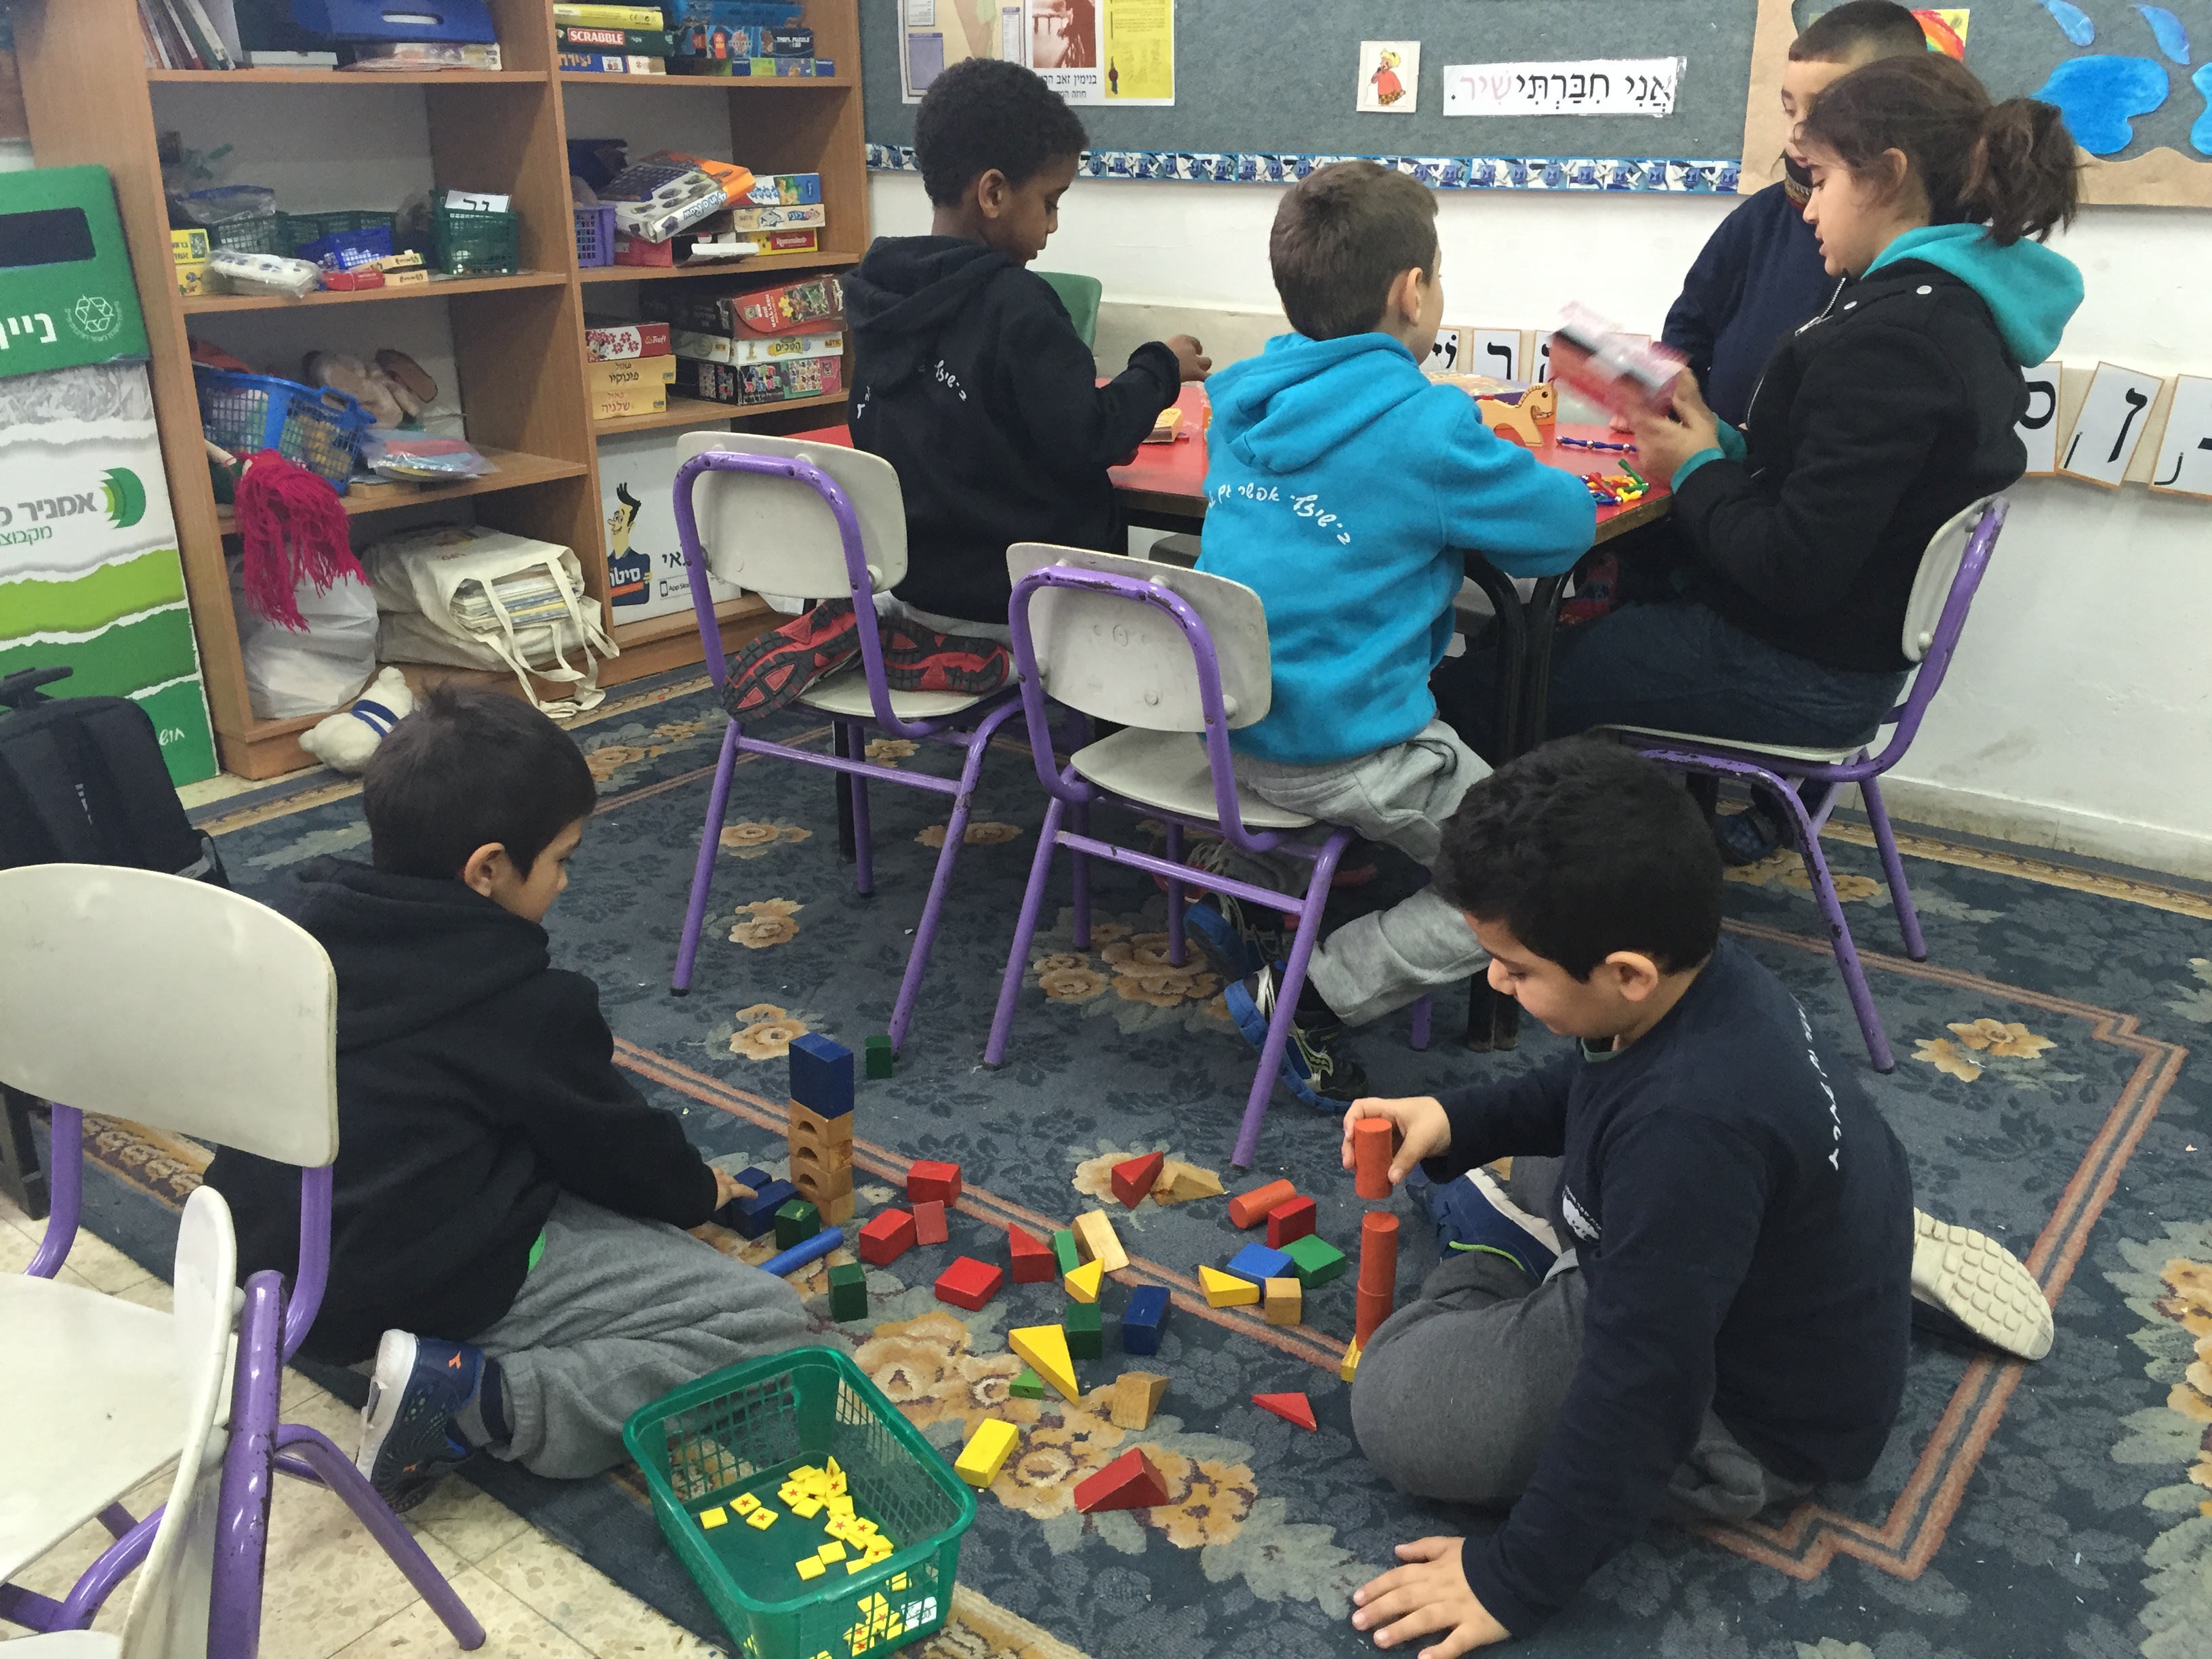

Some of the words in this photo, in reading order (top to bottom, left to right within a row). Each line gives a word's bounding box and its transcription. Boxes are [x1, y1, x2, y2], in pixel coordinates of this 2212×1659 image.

[570, 30, 623, 43] SCRABBLE
[1057, 75, 1071, 84] זאב
[1073, 75, 1097, 86] בנימין
[683, 203, 704, 220] Row
[18, 492, 98, 521] אמניר
